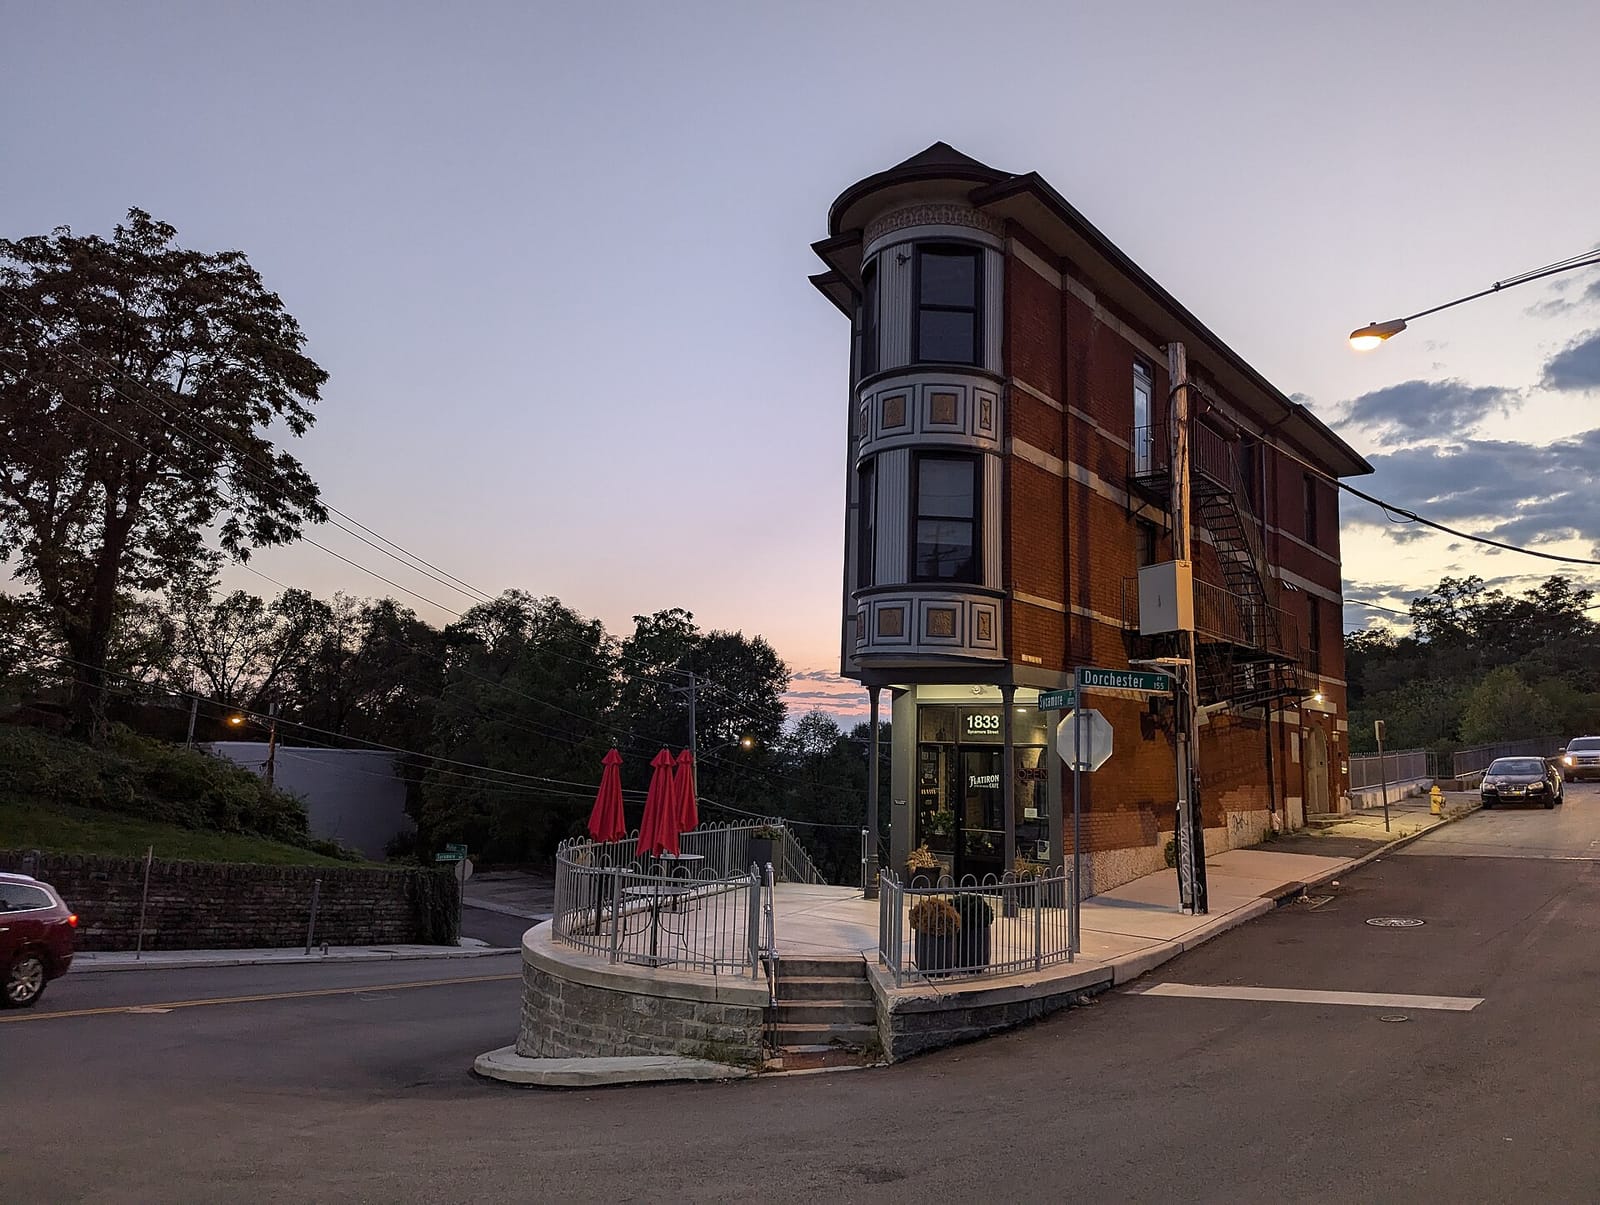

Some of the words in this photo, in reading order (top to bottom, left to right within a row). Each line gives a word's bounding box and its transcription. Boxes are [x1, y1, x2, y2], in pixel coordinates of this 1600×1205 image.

[1084, 670, 1144, 688] Dorchester
[1039, 694, 1063, 710] Sycamore
[966, 715, 999, 729] 1833
[1018, 768, 1048, 779] OPEN
[968, 774, 1000, 788] FLATIRON
